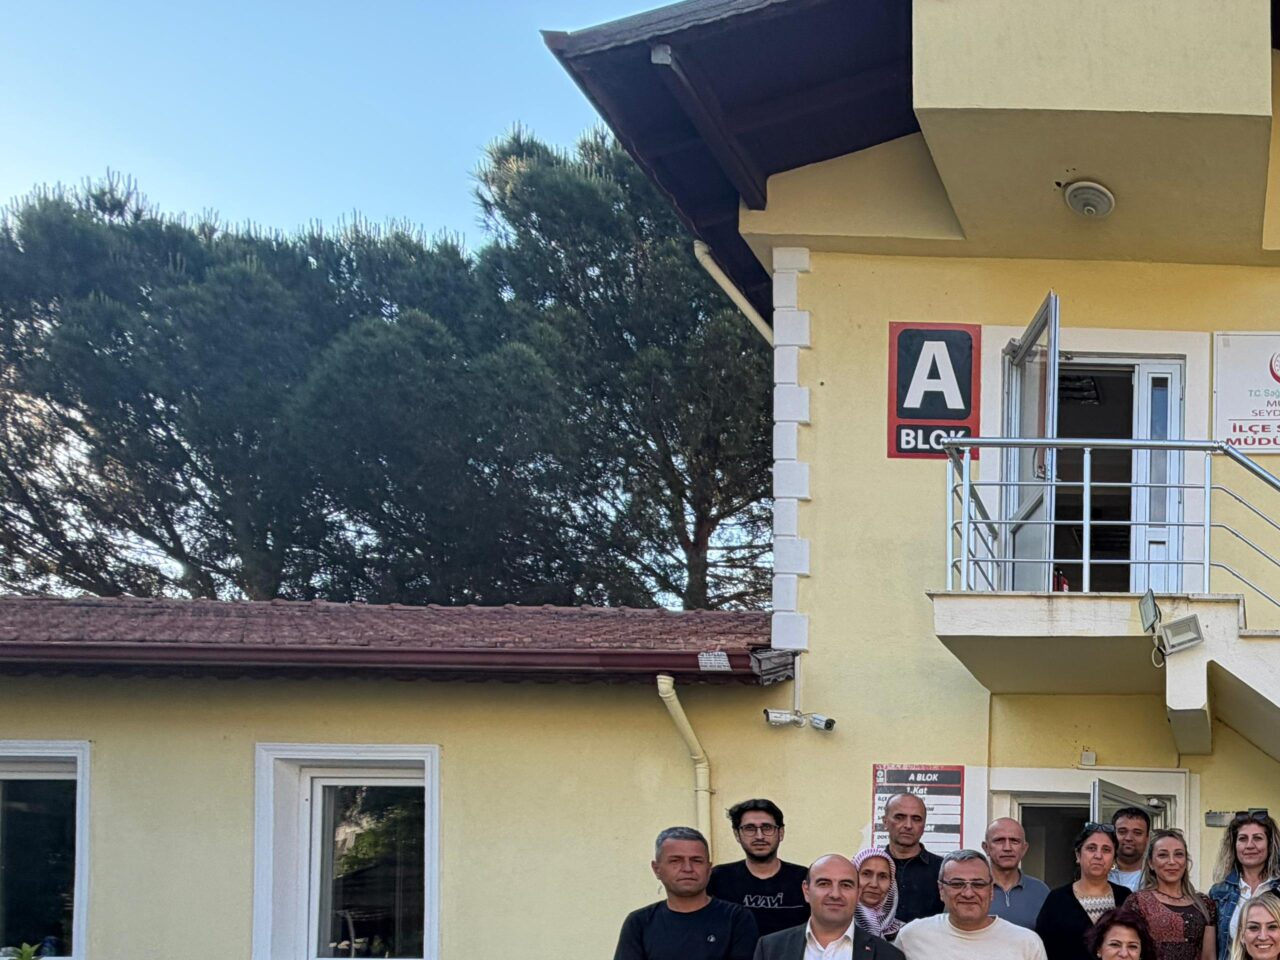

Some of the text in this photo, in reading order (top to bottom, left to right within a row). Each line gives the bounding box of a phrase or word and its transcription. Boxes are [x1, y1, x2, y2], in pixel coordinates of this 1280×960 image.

[903, 341, 965, 409] A
[1232, 422, 1272, 435] İLÇE
[908, 773, 939, 782] A BLOK
